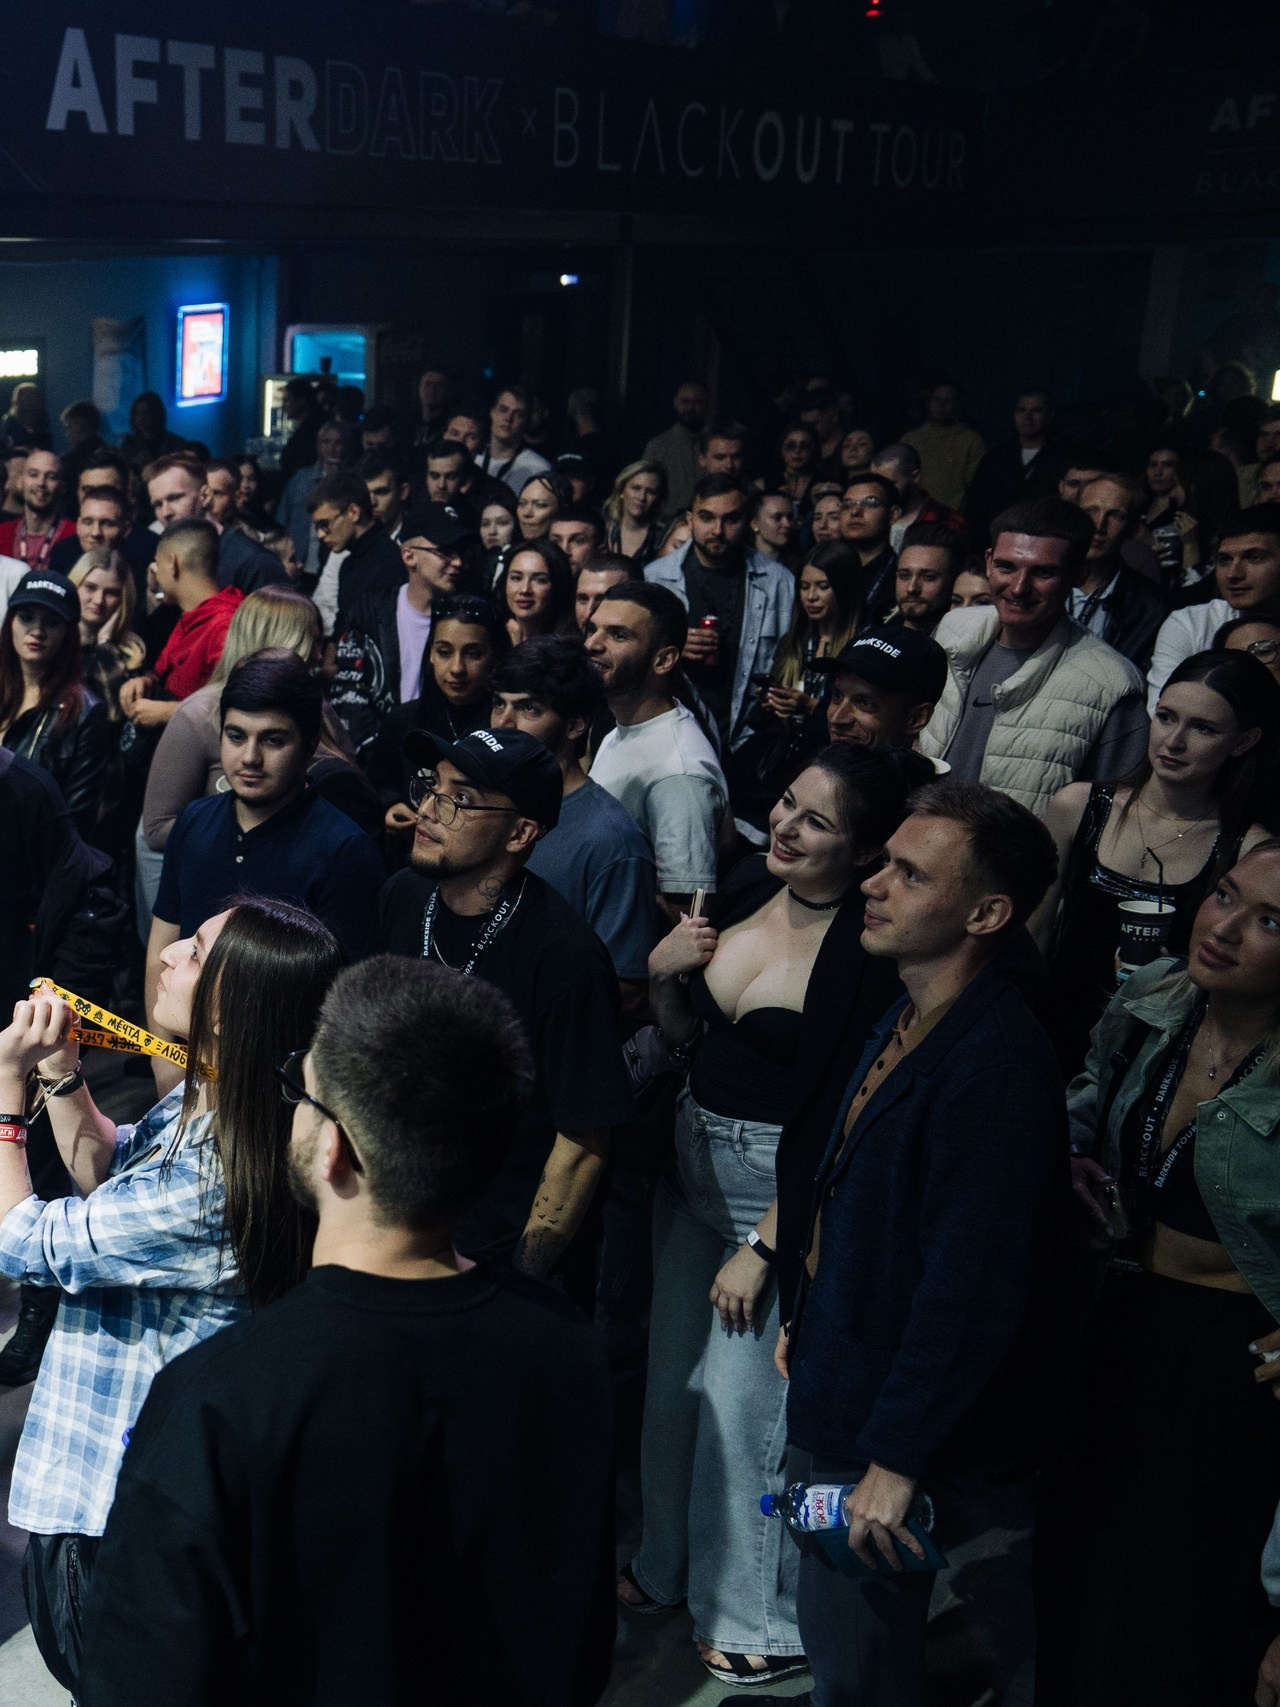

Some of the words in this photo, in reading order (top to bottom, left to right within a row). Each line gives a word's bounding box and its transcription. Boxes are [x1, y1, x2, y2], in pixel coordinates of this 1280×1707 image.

[553, 87, 853, 185] BLACKOUT
[870, 122, 967, 191] TOUR
[422, 916, 432, 957] DARKSIDE
[476, 900, 511, 951] BLACKOUT
[1120, 922, 1161, 938] AFTER
[107, 1016, 140, 1044] МЕЧТА
[1138, 1115, 1157, 1178] BLACKOUT
[1155, 1053, 1180, 1103] DARKSIDE
[1153, 1148, 1179, 1189] DARKSIDE
[1174, 1124, 1198, 1150] TOUR
